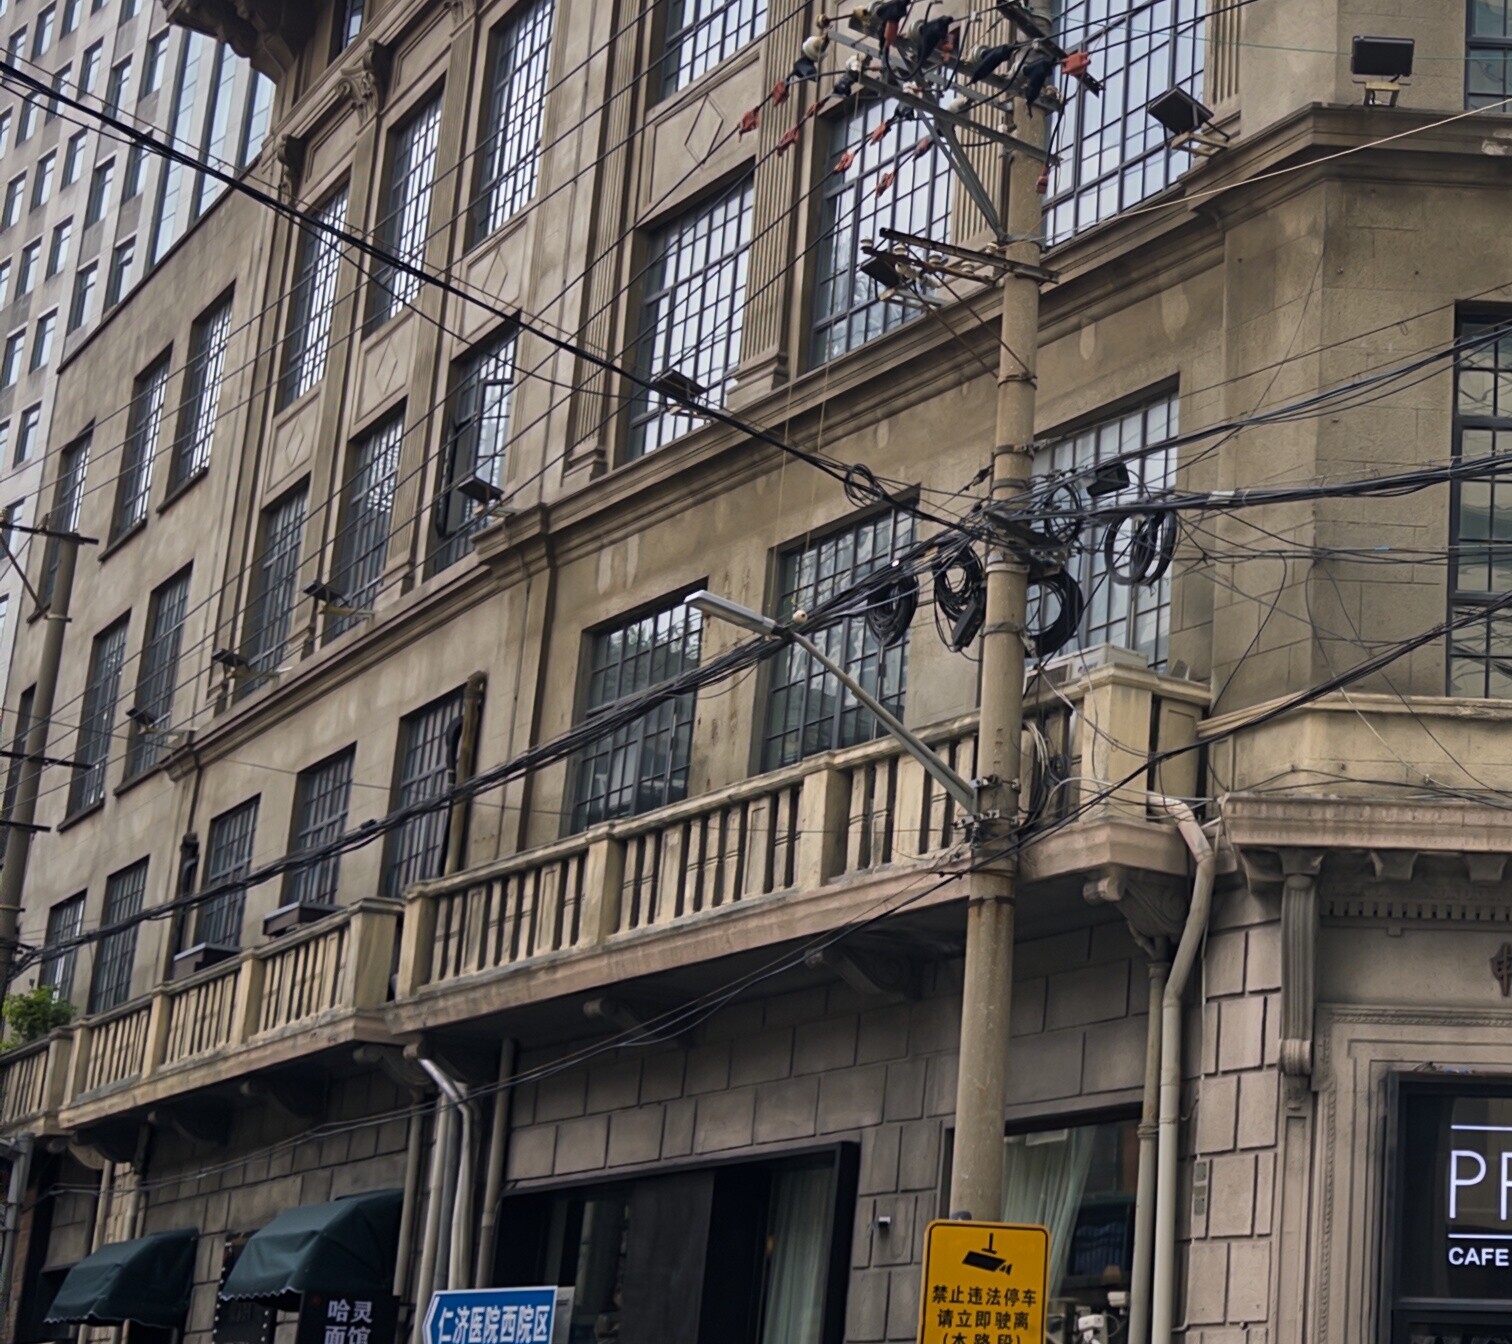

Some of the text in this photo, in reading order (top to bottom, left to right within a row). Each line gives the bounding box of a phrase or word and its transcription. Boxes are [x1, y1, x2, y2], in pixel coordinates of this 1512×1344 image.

[1448, 1247, 1509, 1267] CAFE
[932, 1285, 1037, 1308] 禁止违法停车
[327, 1298, 373, 1324] 哈灵
[937, 1308, 1029, 1331] 请立即驶离
[438, 1304, 551, 1344] 仁济医院西院区
